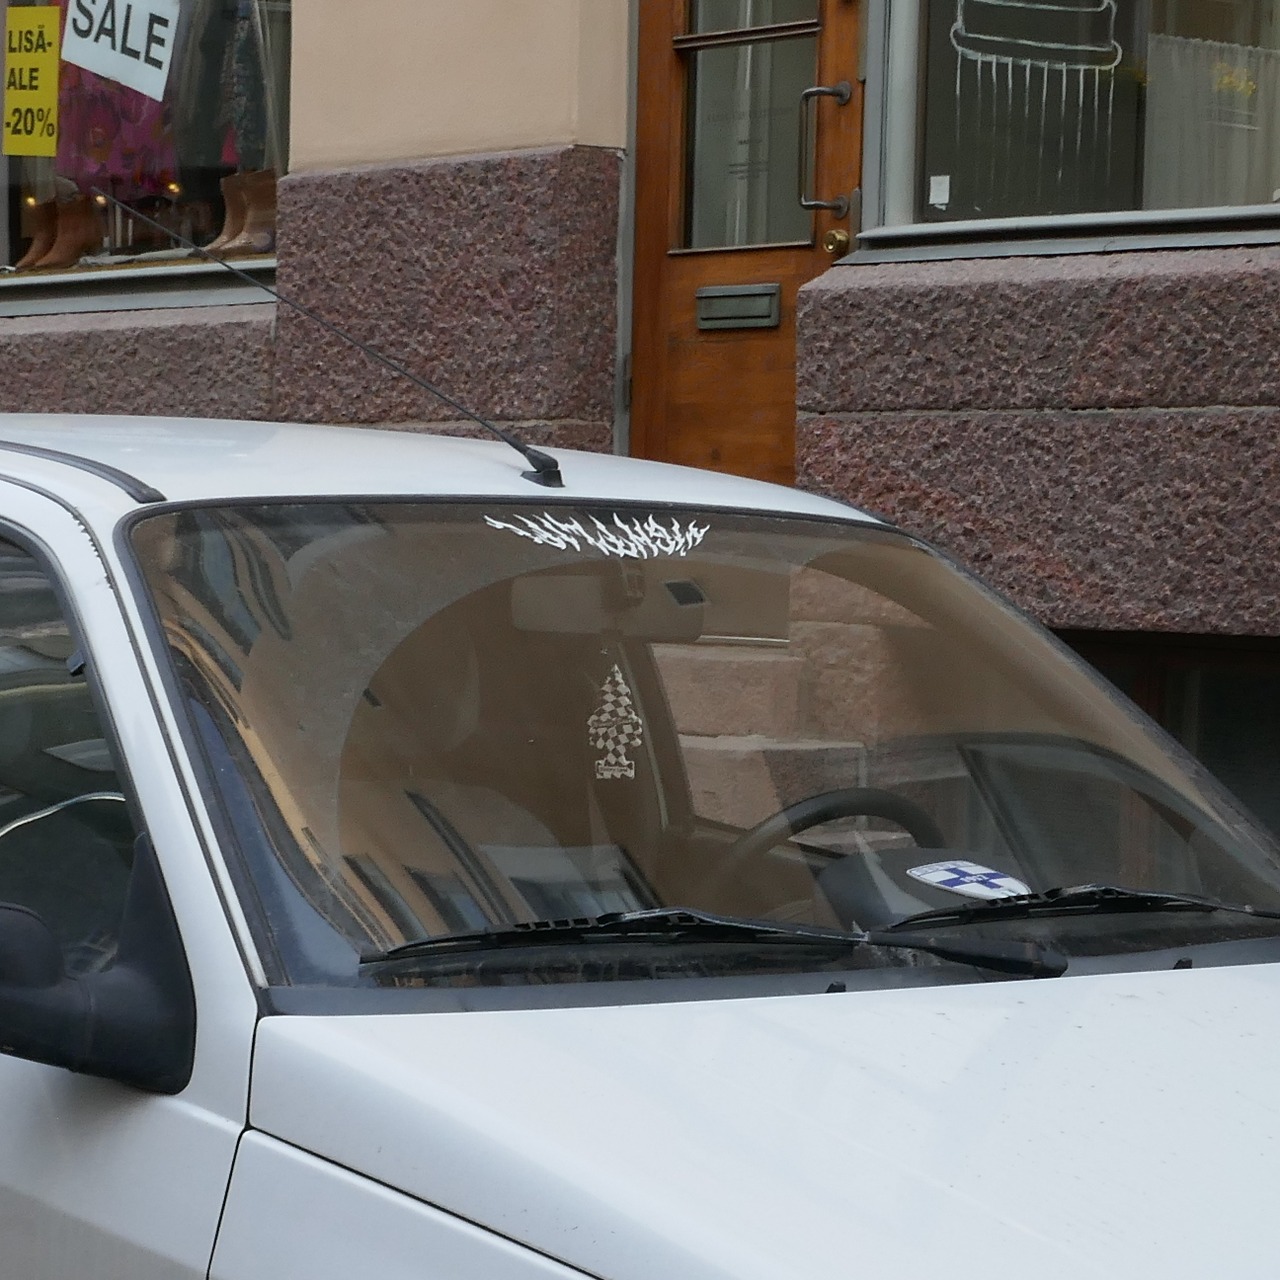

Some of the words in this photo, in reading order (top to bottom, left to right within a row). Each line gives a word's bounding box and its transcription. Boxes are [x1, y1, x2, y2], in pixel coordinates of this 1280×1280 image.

[7, 25, 53, 54] LISÄ-
[72, 0, 169, 70] SALE
[6, 67, 39, 91] ALE
[5, 107, 55, 138] -20%
